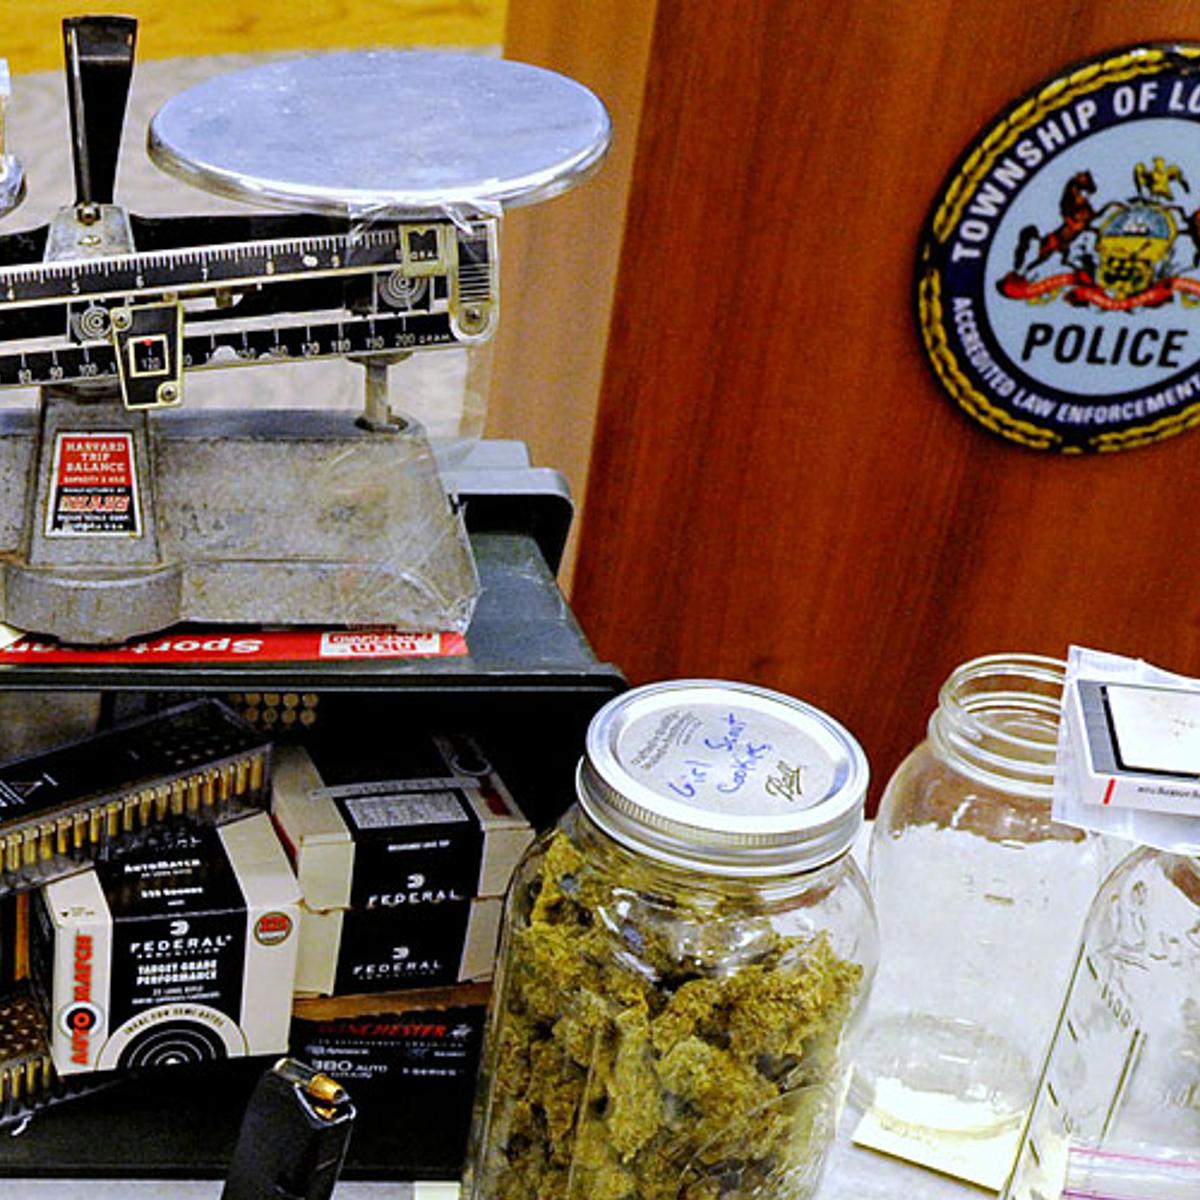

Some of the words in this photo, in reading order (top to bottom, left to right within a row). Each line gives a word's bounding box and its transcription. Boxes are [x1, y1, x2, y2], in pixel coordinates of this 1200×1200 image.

[951, 99, 1098, 262] TOWNSHIP
[1113, 81, 1159, 116] OF
[1022, 323, 1188, 368] POLICE
[19, 369, 32, 384] 80
[50, 366, 63, 380] 90
[78, 362, 97, 377] 100
[395, 333, 416, 348] 200
[953, 297, 1014, 394] ACCREDITED
[1011, 385, 1056, 418] LAW
[66, 442, 125, 452] HARVARD
[81, 453, 111, 462] TRIP
[66, 462, 126, 473] BALANCE
[367, 889, 462, 908] FEDERAL
[129, 935, 225, 954] FEDERAL
[352, 959, 443, 976] FEDERAL
[69, 934, 94, 1066] AUTOMATCH
[355, 1063, 389, 1074] AUTO
